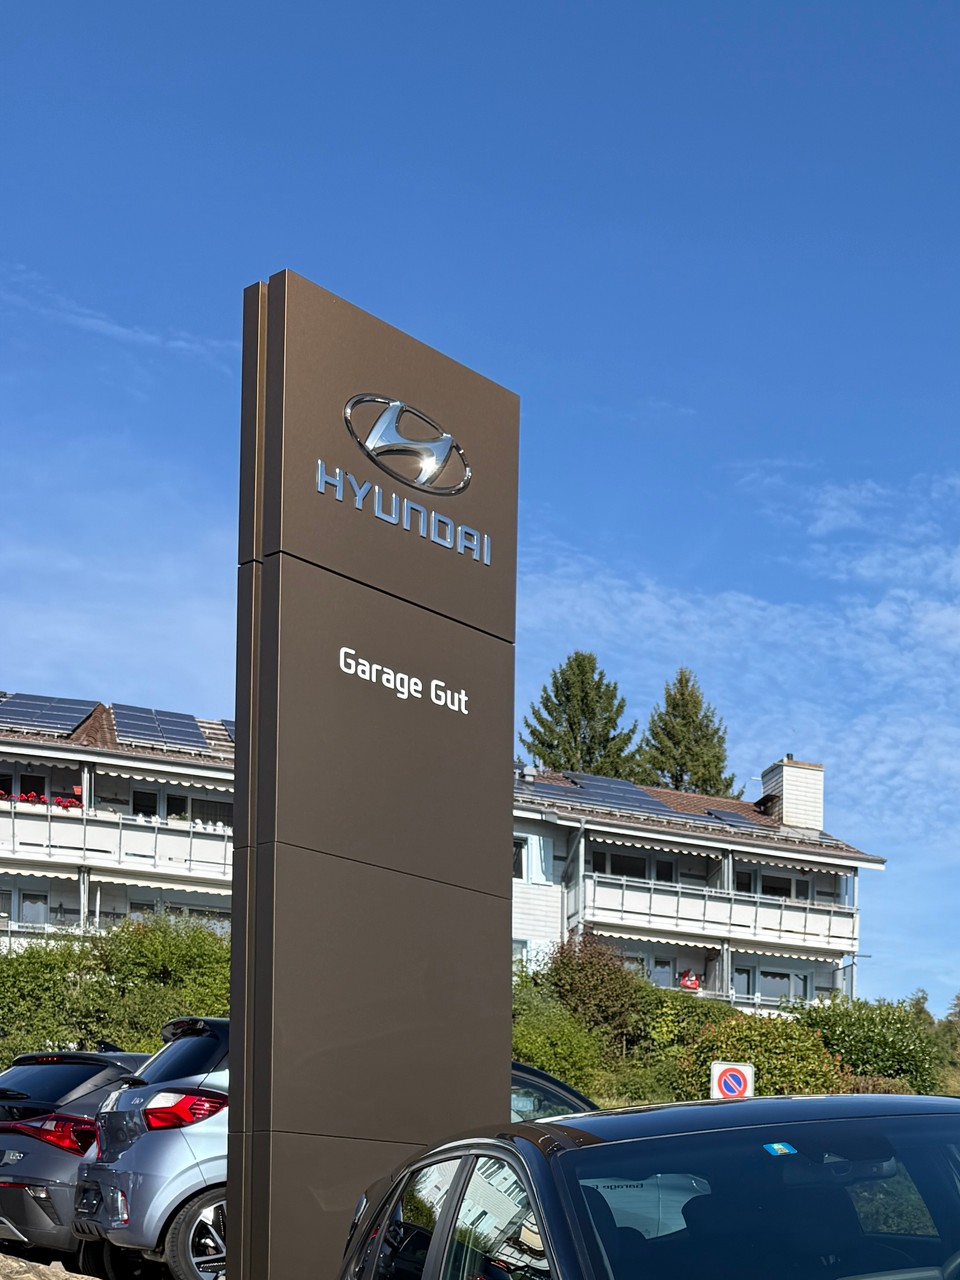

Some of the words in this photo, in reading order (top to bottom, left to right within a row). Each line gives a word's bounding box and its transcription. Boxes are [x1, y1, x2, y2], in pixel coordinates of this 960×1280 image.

[316, 459, 491, 566] HYUNDAI
[339, 646, 423, 700] Garage
[430, 679, 469, 715] Gut
